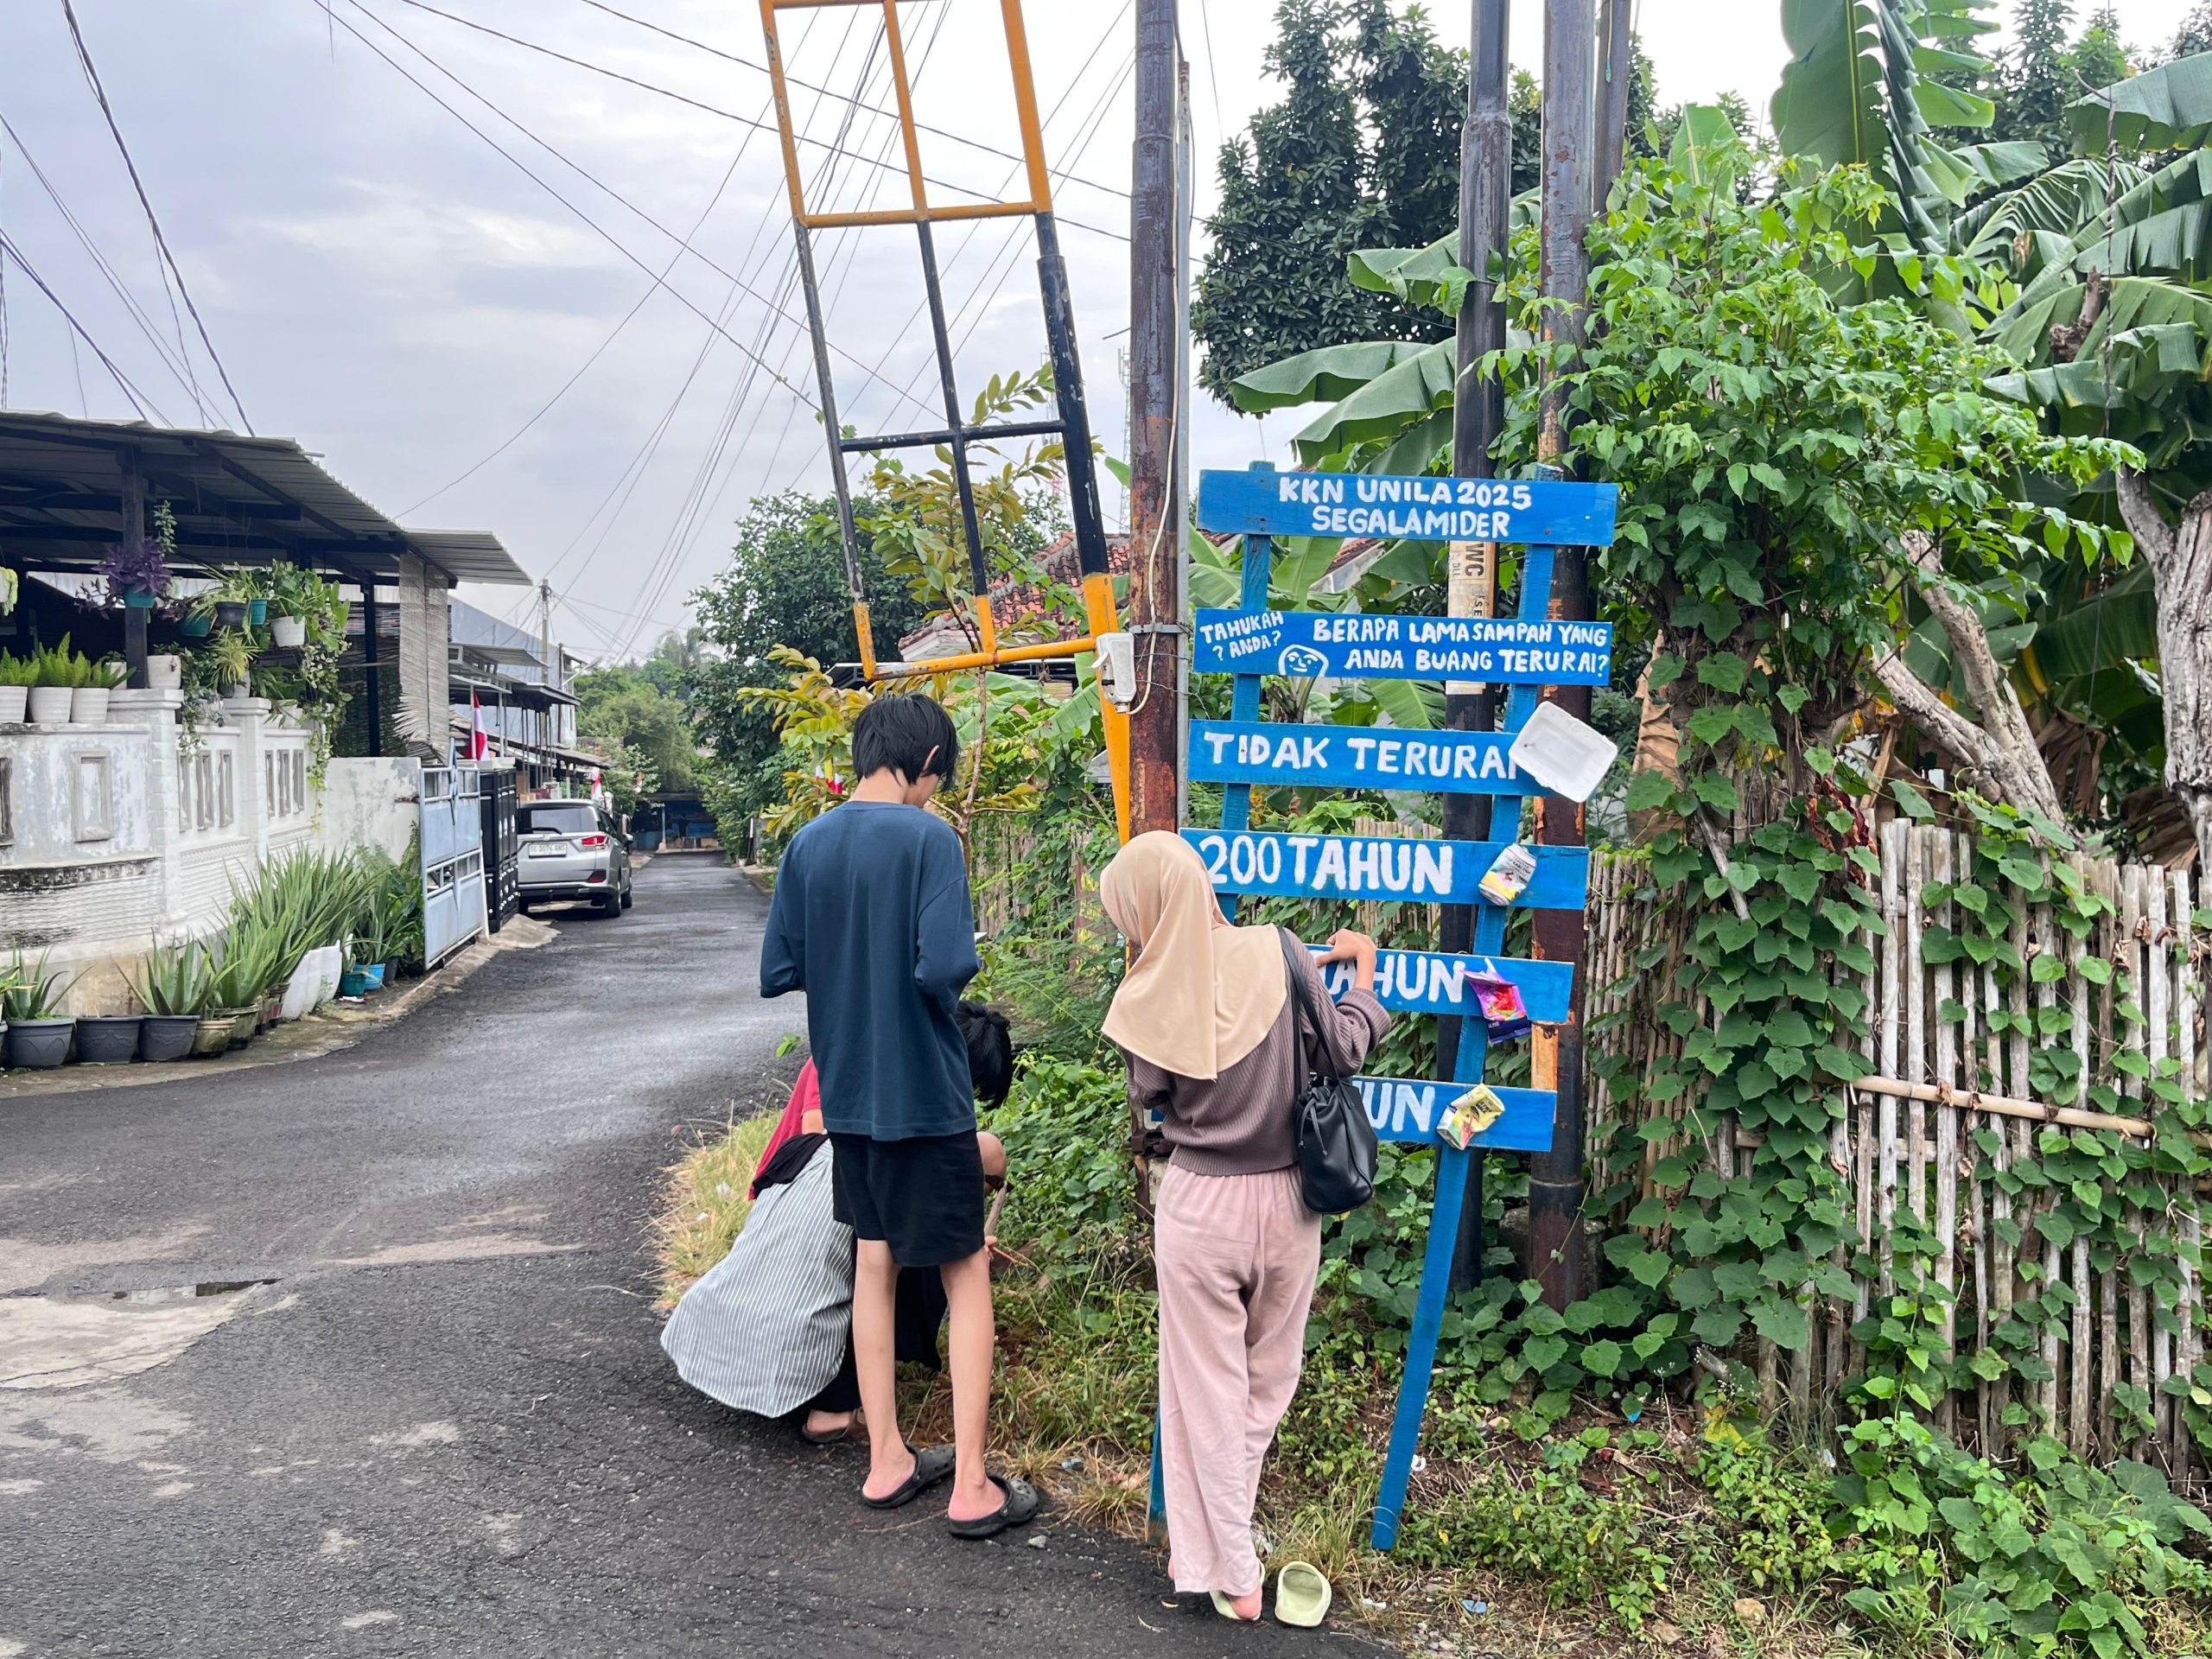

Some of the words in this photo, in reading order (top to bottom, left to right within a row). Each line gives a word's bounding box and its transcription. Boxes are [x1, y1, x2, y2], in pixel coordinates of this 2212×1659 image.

[1279, 476, 1344, 504] KKN
[1357, 477, 1452, 505] UNILA
[1456, 480, 1533, 511] 2025
[1311, 505, 1510, 539] SEGALAMIDER
[1465, 543, 1484, 577] WC
[1199, 611, 1284, 644] TAHUKAH
[1229, 630, 1282, 658] ANDA?
[1313, 617, 1400, 643] BERAPA
[1408, 621, 1470, 645] LAMA
[1471, 622, 1554, 644] SAMPAH
[1557, 624, 1608, 647] YANG
[1344, 648, 1404, 671] ANDA
[1415, 649, 1493, 672] BUANG
[1497, 649, 1611, 678] TERURAI?
[1204, 731, 1331, 769] TIDAK
[1346, 737, 1517, 780] TERURAI
[1198, 835, 1281, 886] 200
[1286, 836, 1453, 895] TAHUN
